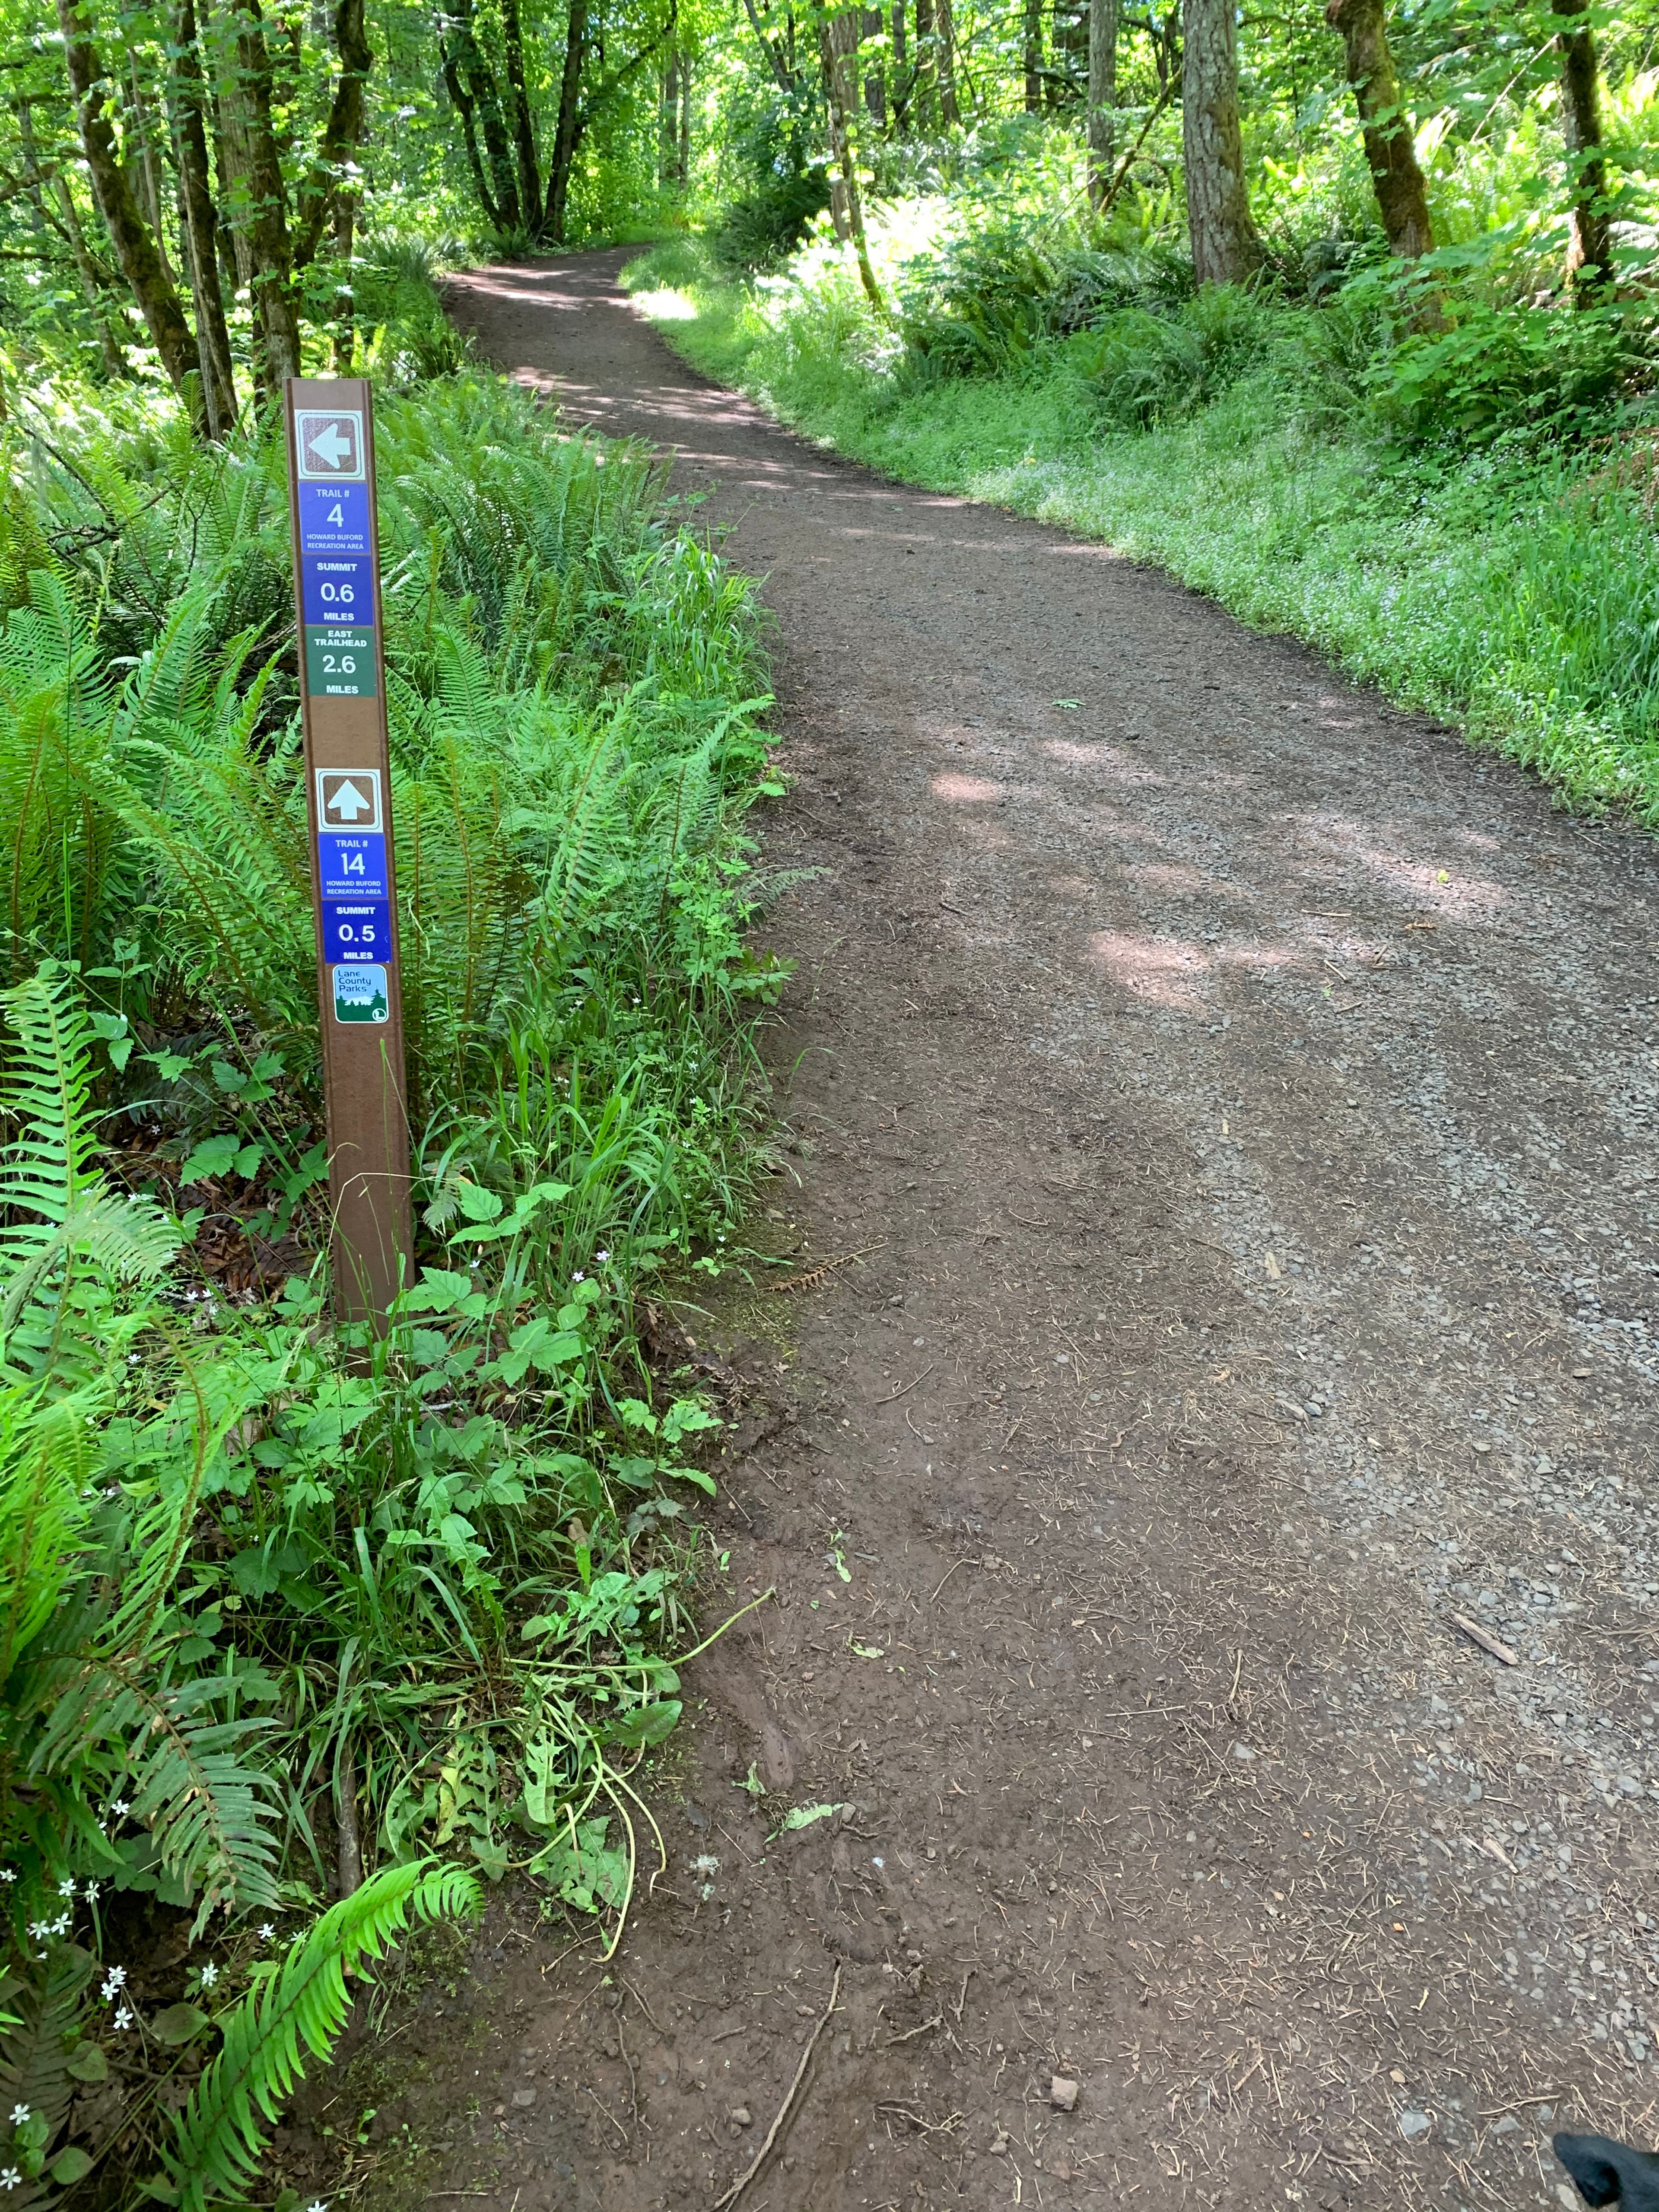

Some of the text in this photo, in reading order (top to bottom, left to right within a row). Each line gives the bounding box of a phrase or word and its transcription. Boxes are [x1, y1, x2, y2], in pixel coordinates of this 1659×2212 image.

[316, 489, 343, 497] TRAIL
[327, 503, 344, 527] 4
[317, 563, 357, 571] SUMMIT
[321, 582, 354, 602] 0.6
[324, 612, 355, 621] MILES
[314, 639, 367, 647] TRAILHEAD
[322, 655, 356, 674] 2.6
[326, 685, 359, 694] MILES
[335, 839, 361, 848] TRAIL
[341, 853, 365, 875] 14
[336, 906, 375, 915] SUMMIT
[339, 924, 375, 942] 0.5
[339, 977, 371, 985] County
